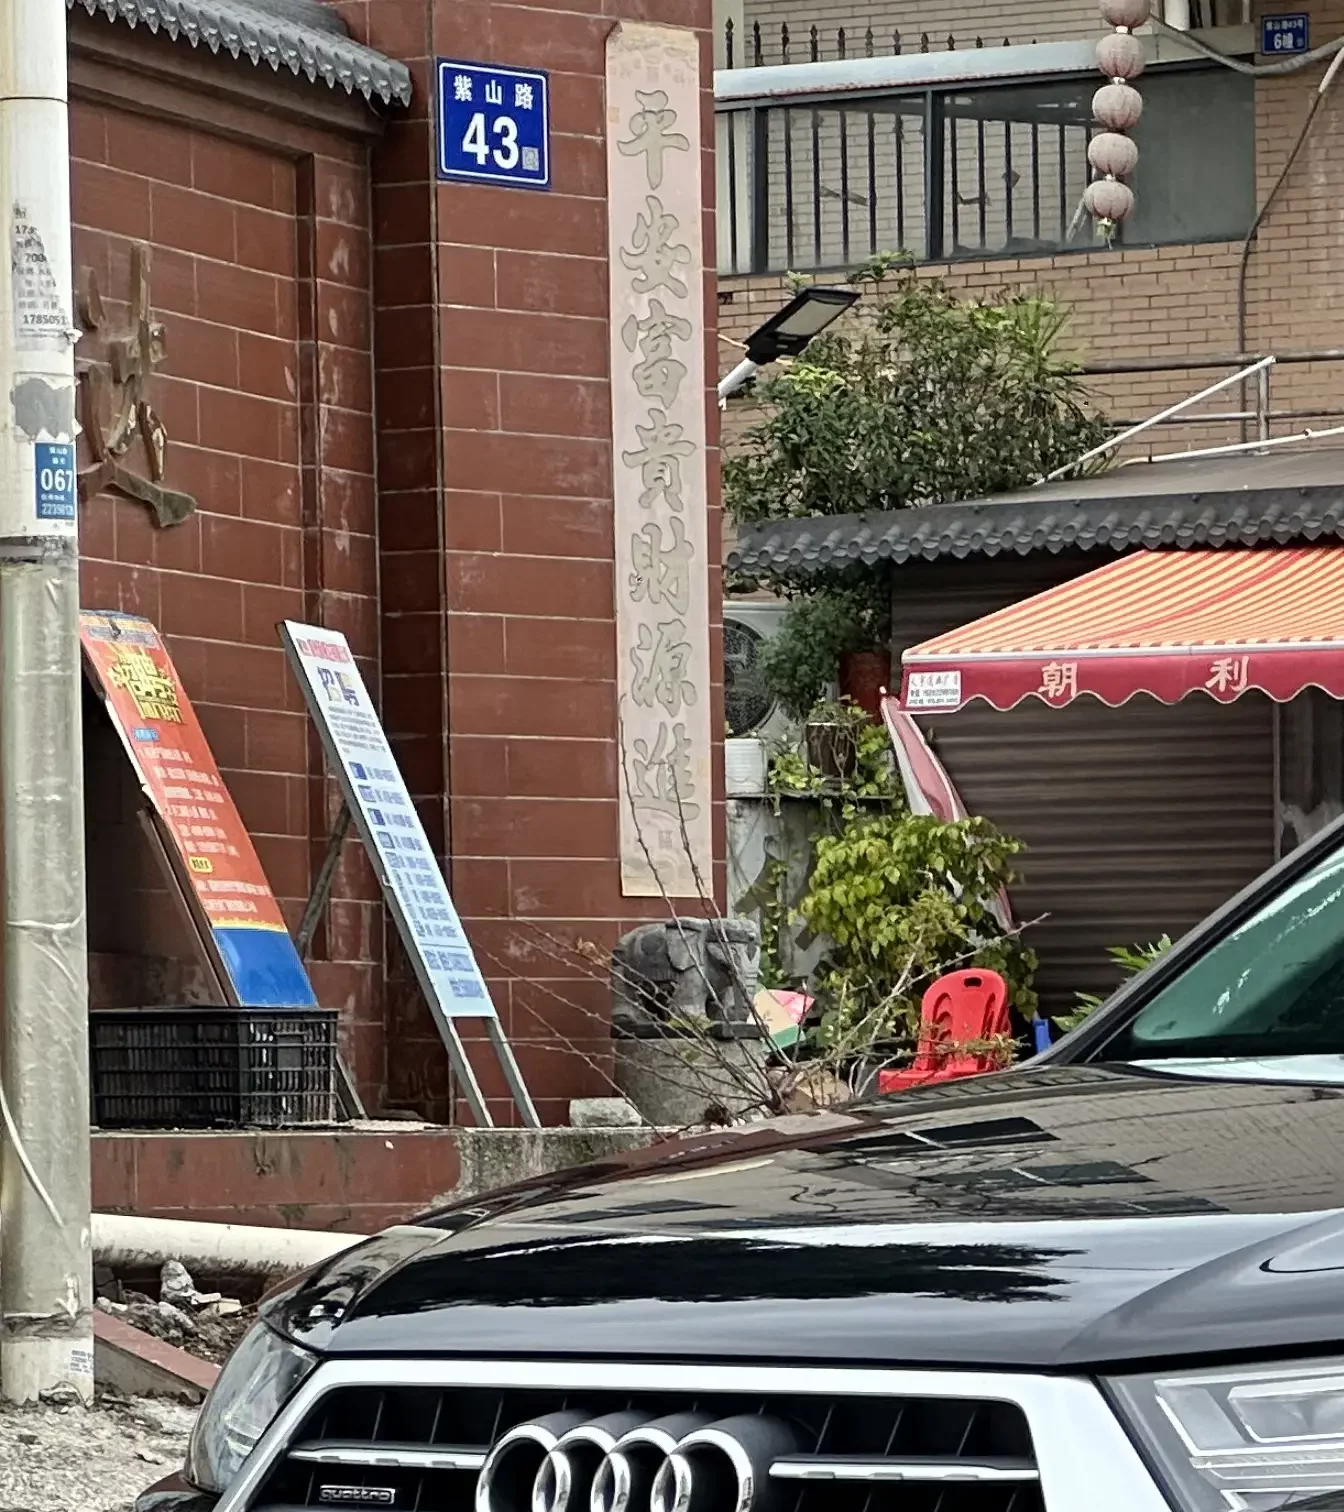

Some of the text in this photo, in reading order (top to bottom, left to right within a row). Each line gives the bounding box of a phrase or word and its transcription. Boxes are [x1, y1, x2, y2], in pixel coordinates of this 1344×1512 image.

[454, 74, 534, 110] 紫山路
[462, 112, 519, 169] 43
[41, 468, 73, 492] 067
[320, 1488, 391, 1502] quattro
